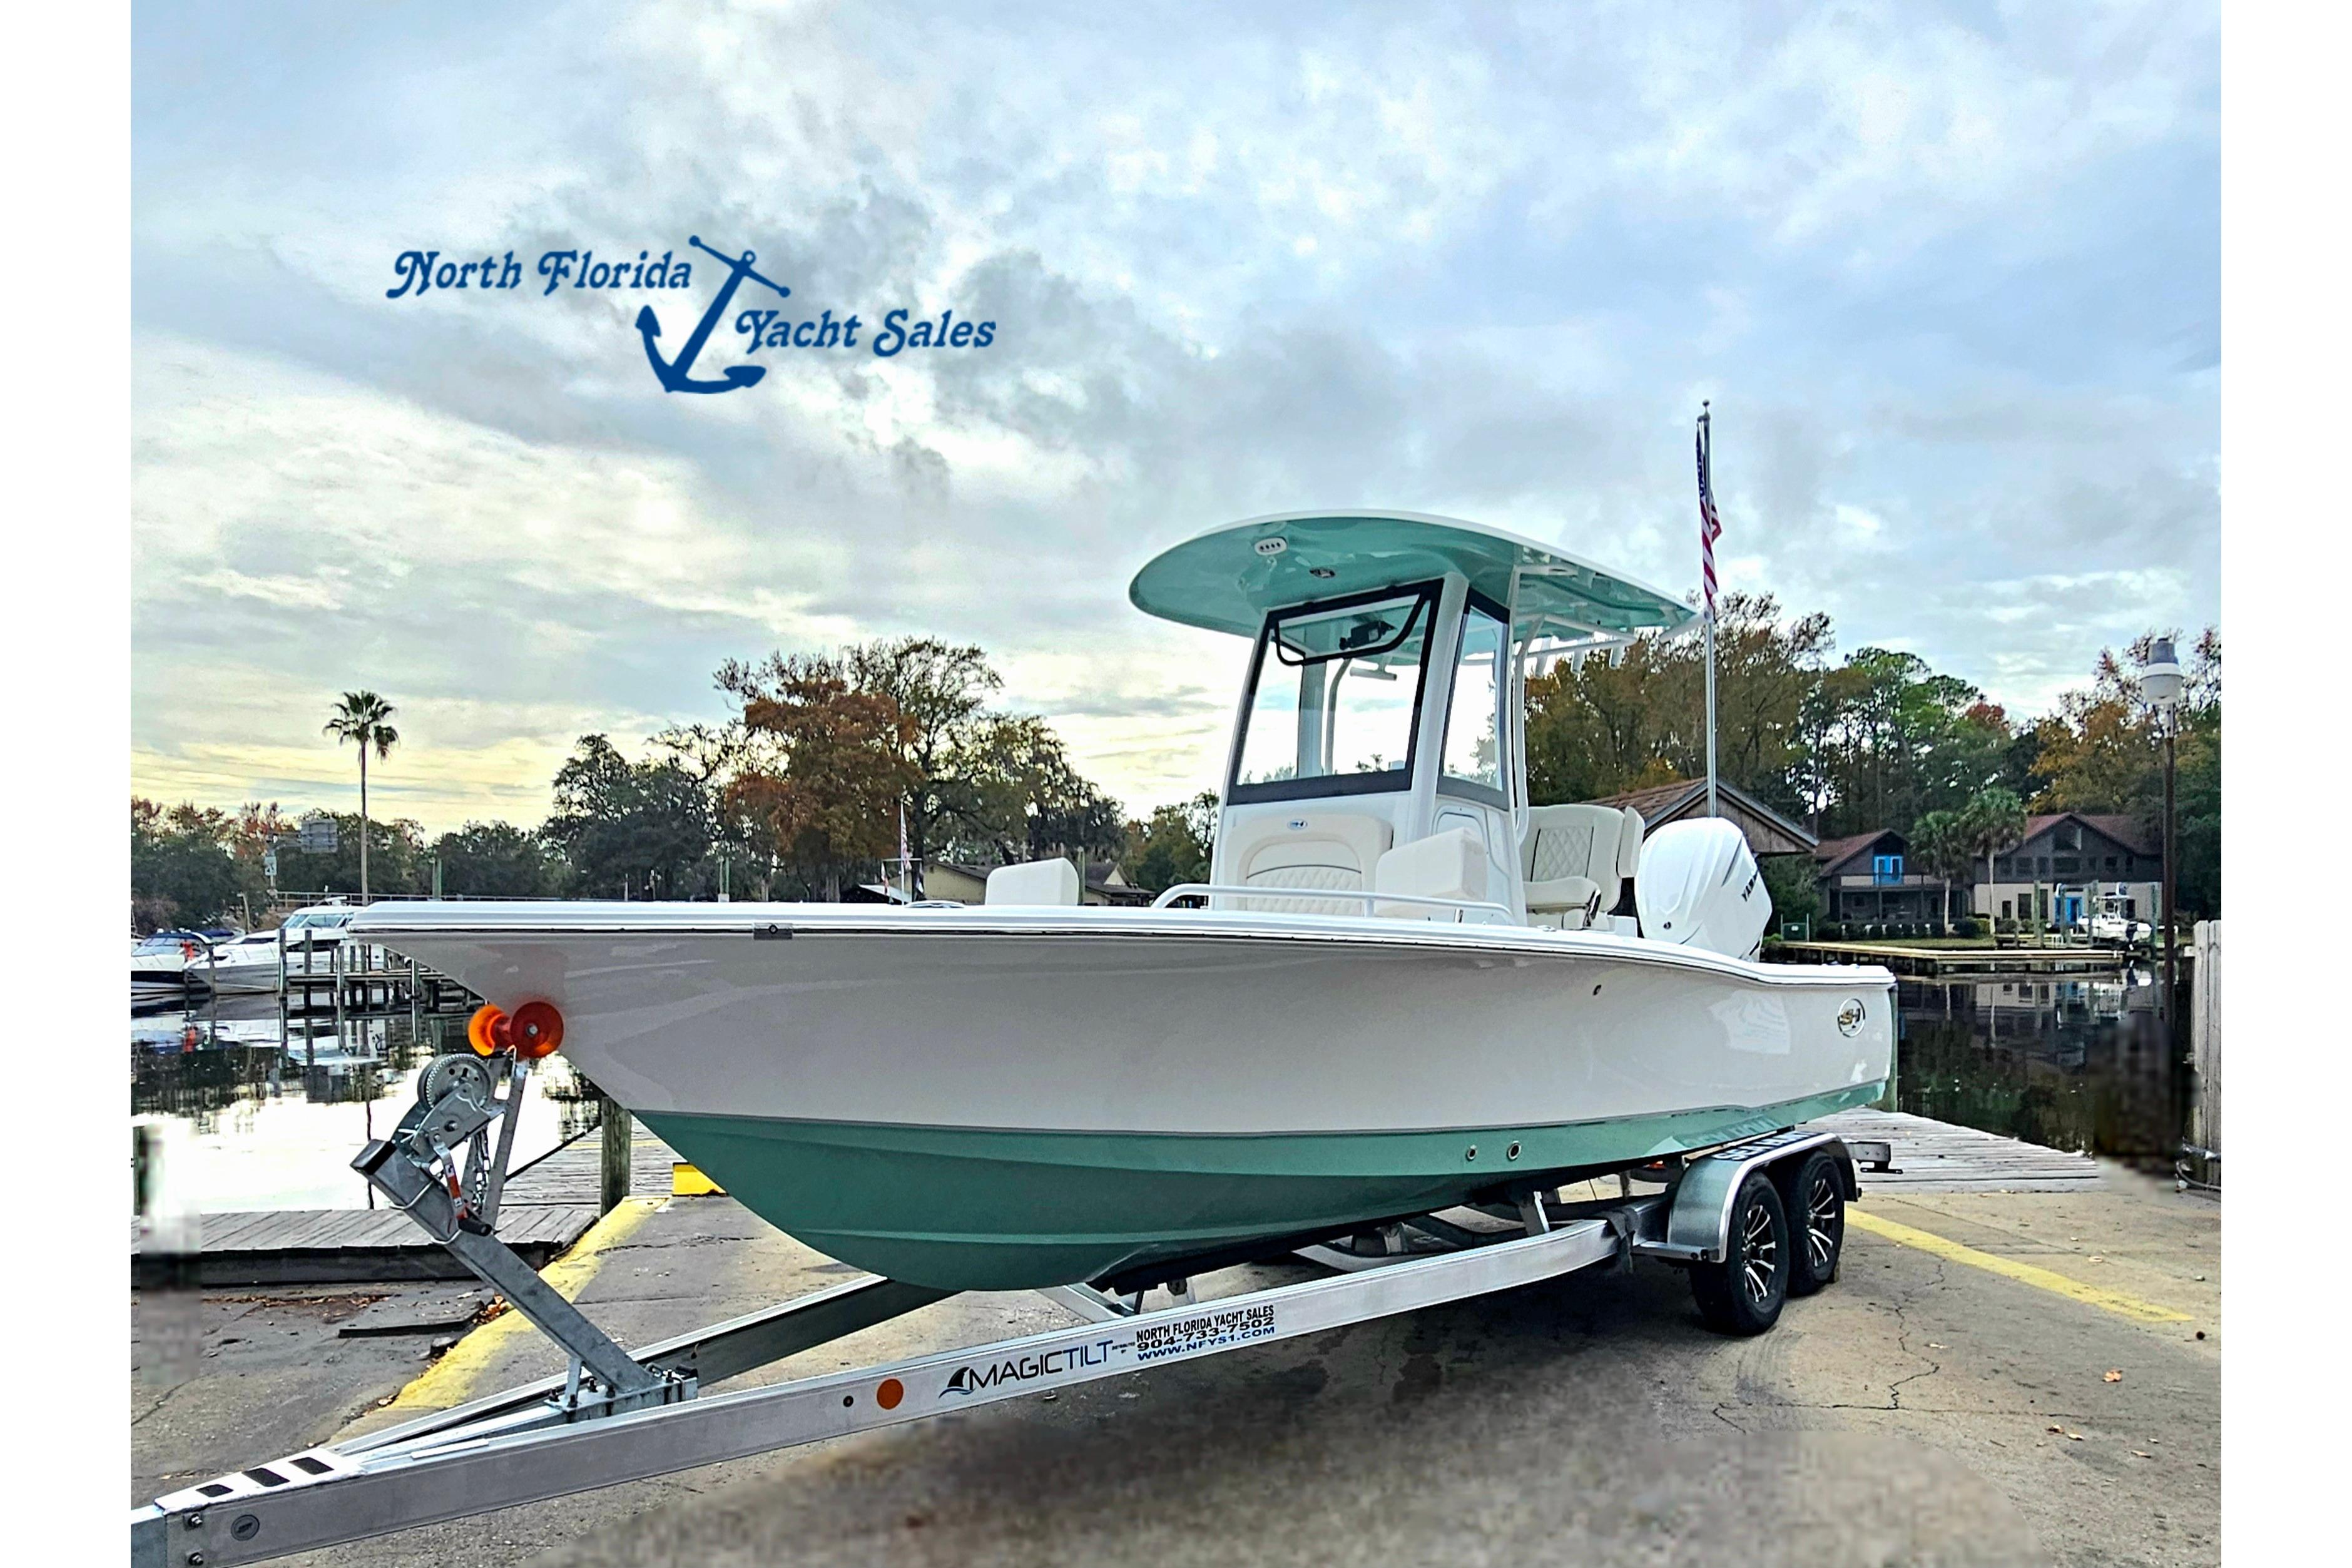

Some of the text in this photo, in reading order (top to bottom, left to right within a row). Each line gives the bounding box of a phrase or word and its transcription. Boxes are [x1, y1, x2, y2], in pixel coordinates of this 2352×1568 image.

[1136, 1305, 1274, 1343] NORTH FLORIDA YACHT SALES
[1137, 1316, 1275, 1352] 904-733-7502
[1138, 1326, 1275, 1361] WWW.NFYS1.COM
[969, 1340, 1113, 1388] MAGICTILT
